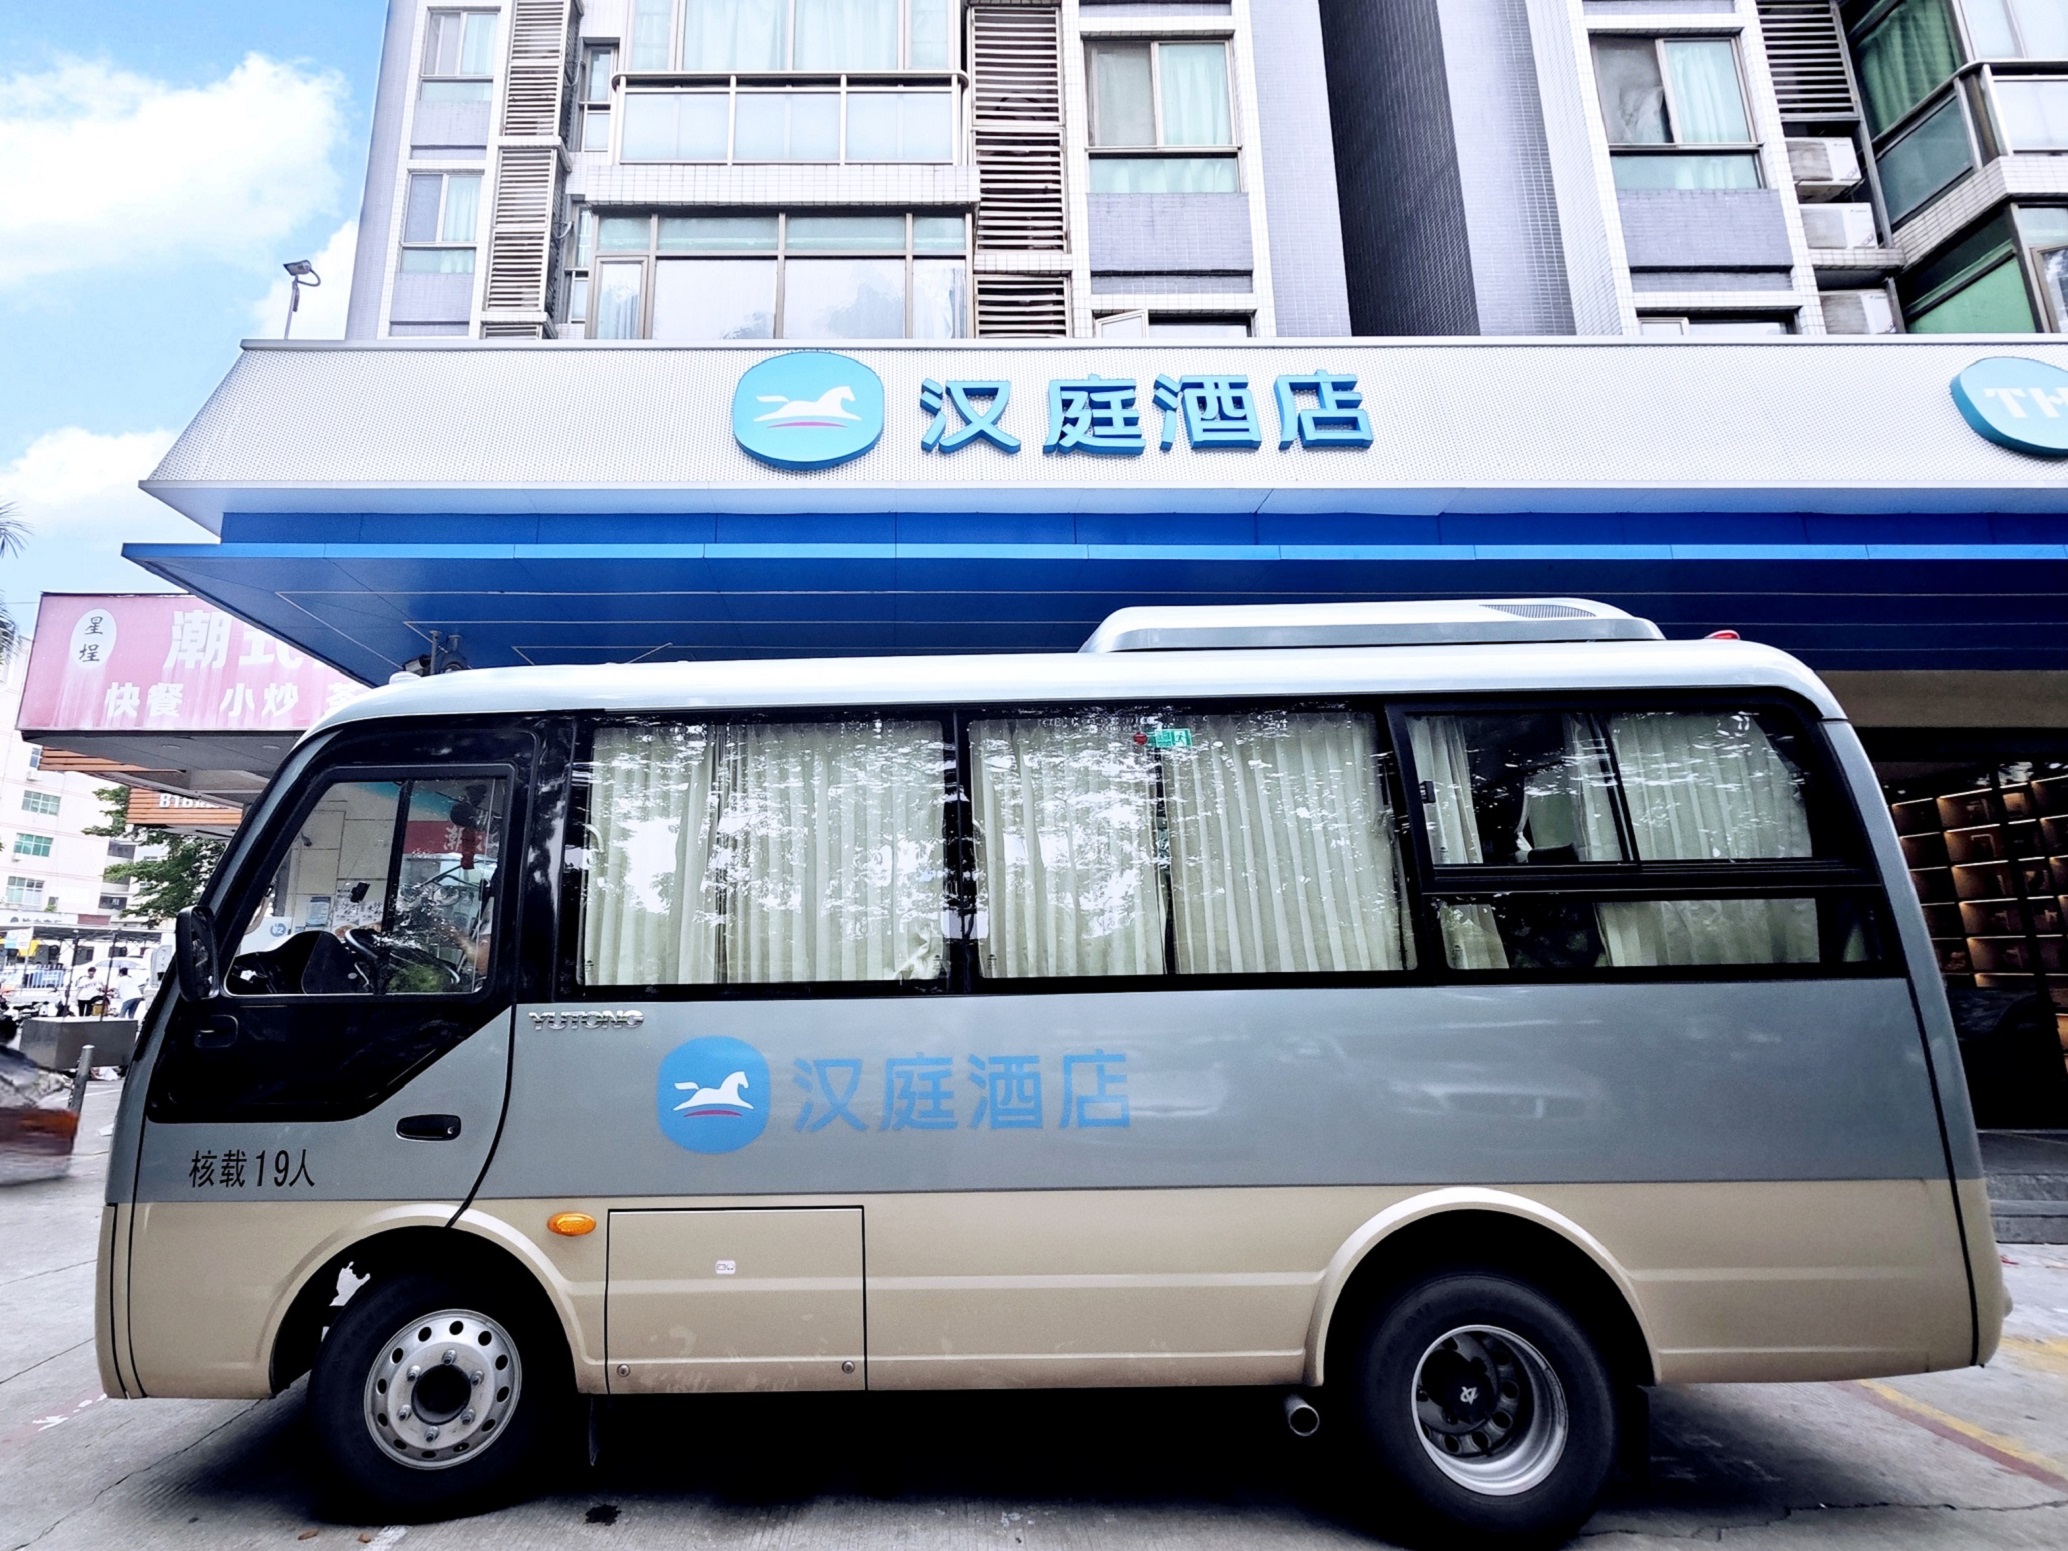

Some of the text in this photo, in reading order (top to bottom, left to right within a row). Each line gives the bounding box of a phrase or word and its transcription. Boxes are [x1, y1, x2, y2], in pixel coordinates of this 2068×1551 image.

[920, 369, 1374, 455] 汉庭酒店
[104, 682, 184, 718] 快餐
[219, 682, 299, 718] 小炒
[528, 1009, 645, 1031] YUTONG
[792, 1048, 1133, 1133] 汉庭酒店
[188, 1148, 316, 1189] 核载19人
